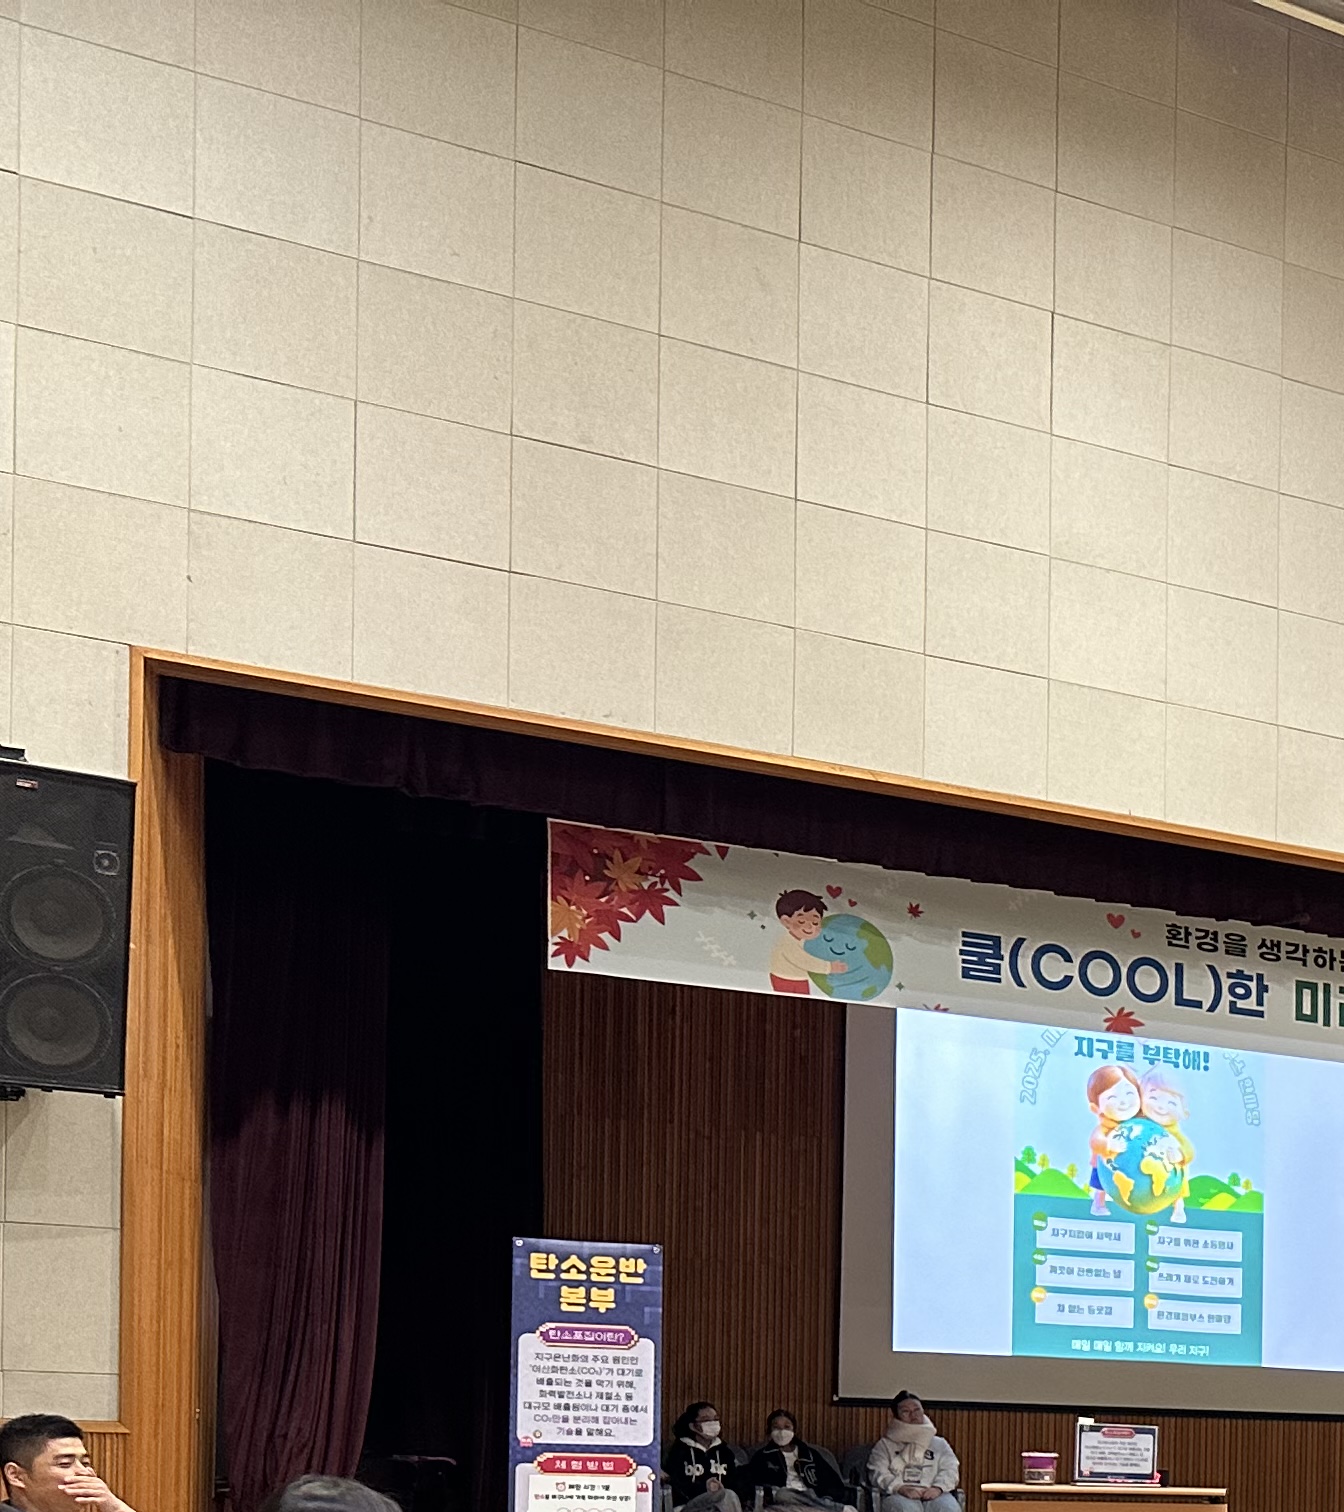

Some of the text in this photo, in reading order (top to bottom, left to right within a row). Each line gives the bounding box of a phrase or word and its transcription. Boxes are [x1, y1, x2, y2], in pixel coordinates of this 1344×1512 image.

[1165, 923, 1248, 957] 환경을
[959, 931, 1269, 1019] 쿨(COOL)한
[1074, 1036, 1135, 1062] 지구를
[1143, 1044, 1210, 1071] 부탁해!
[529, 1252, 648, 1284] 탄소운반
[559, 1284, 617, 1314] 본부
